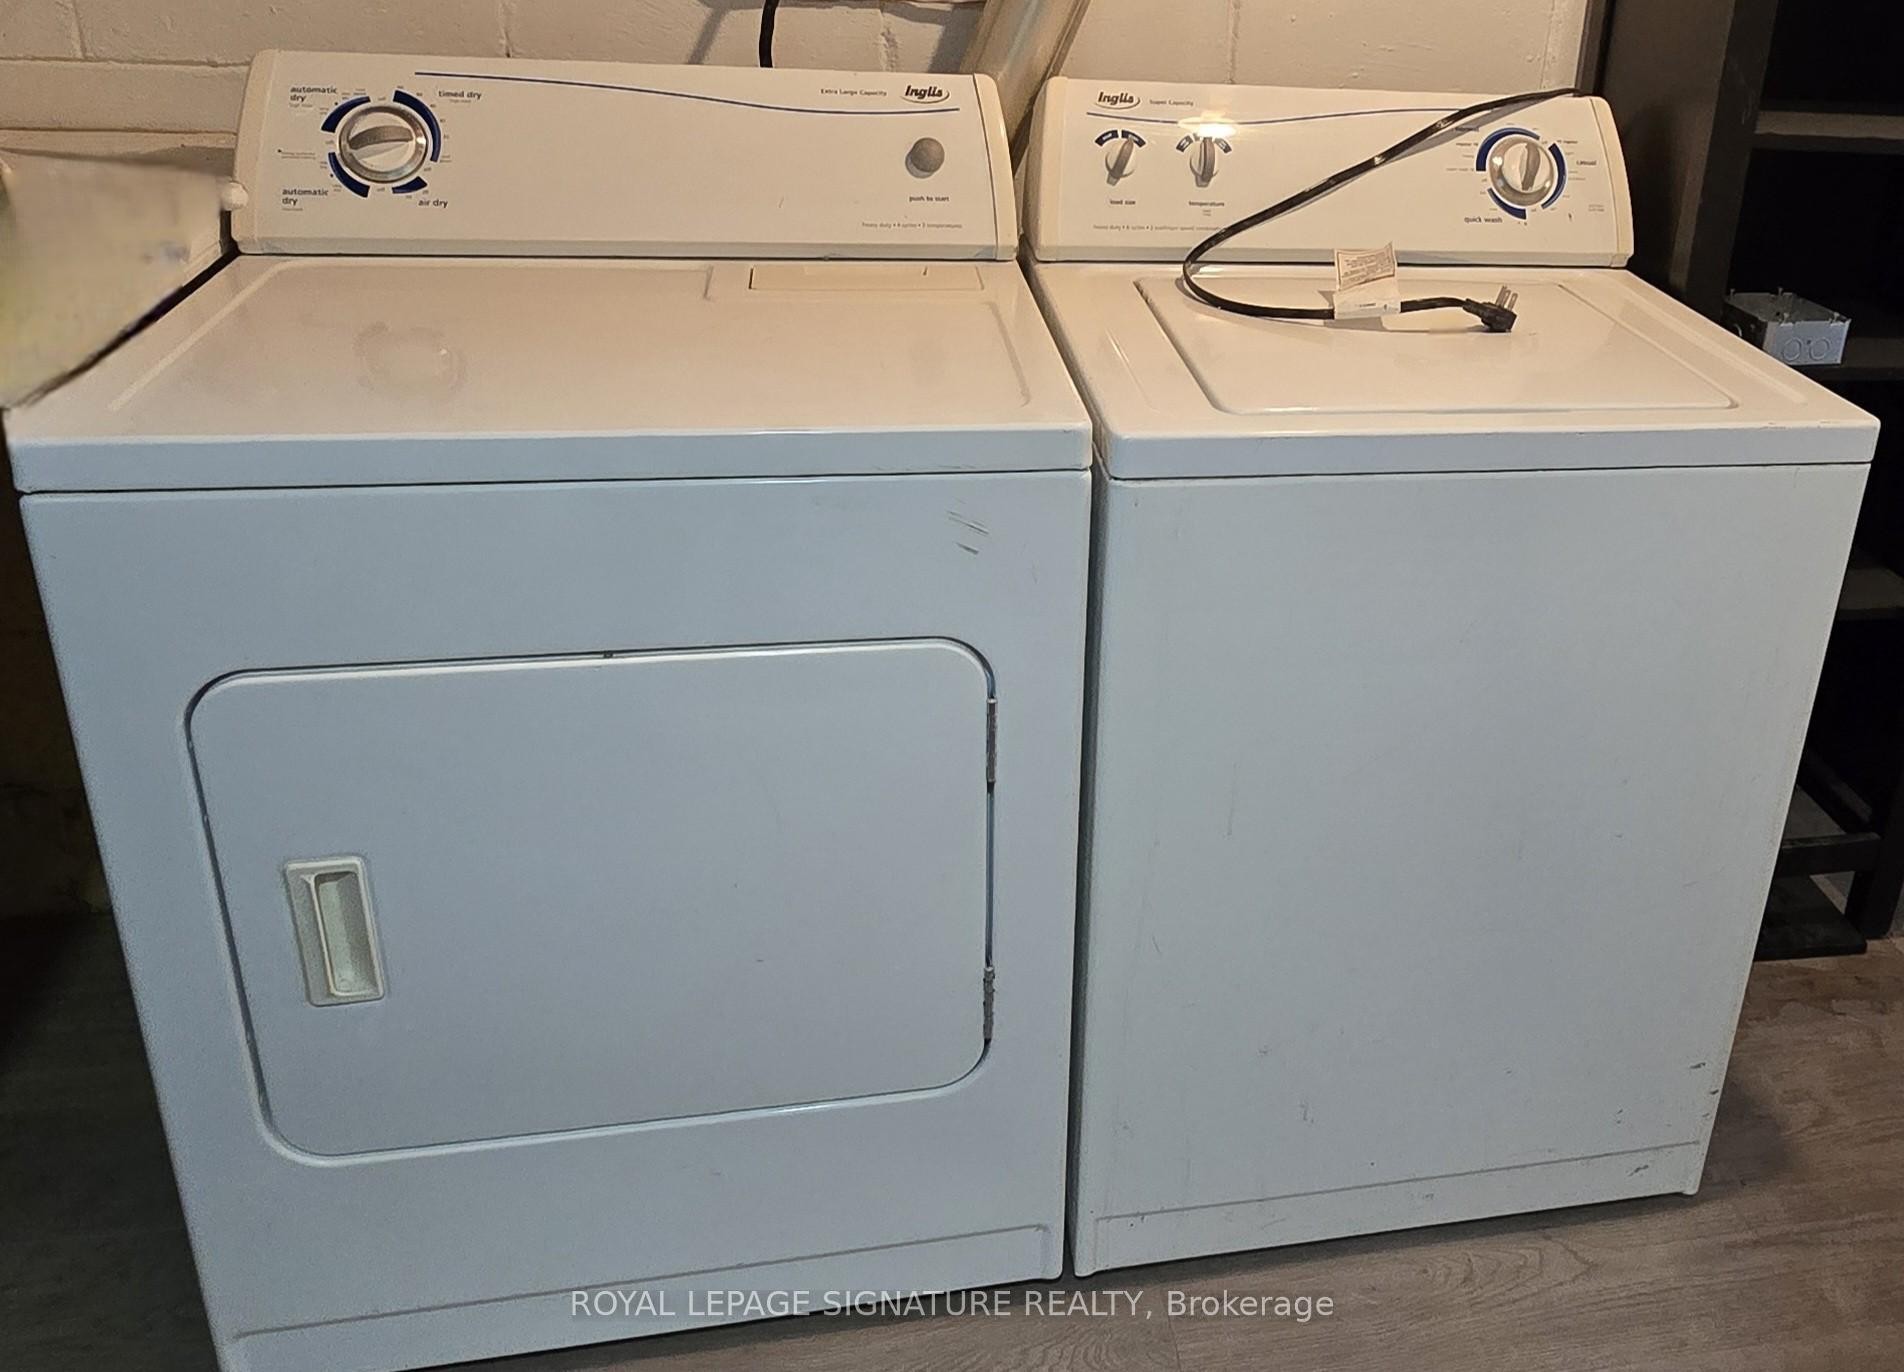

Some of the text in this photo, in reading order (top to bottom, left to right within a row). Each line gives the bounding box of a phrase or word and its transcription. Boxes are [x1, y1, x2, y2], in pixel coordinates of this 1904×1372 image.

[290, 85, 337, 94] automatic
[839, 88, 858, 96] Large
[860, 89, 887, 97] Capacity
[904, 84, 943, 100] Inglis
[290, 94, 307, 102] dry
[438, 90, 482, 100] timed dry
[1098, 91, 1135, 105] Inglis
[1168, 99, 1194, 107] Capacity
[282, 188, 328, 196] automatic
[282, 197, 298, 206] dry
[418, 199, 448, 209] air dry
[1463, 216, 1482, 224] quick
